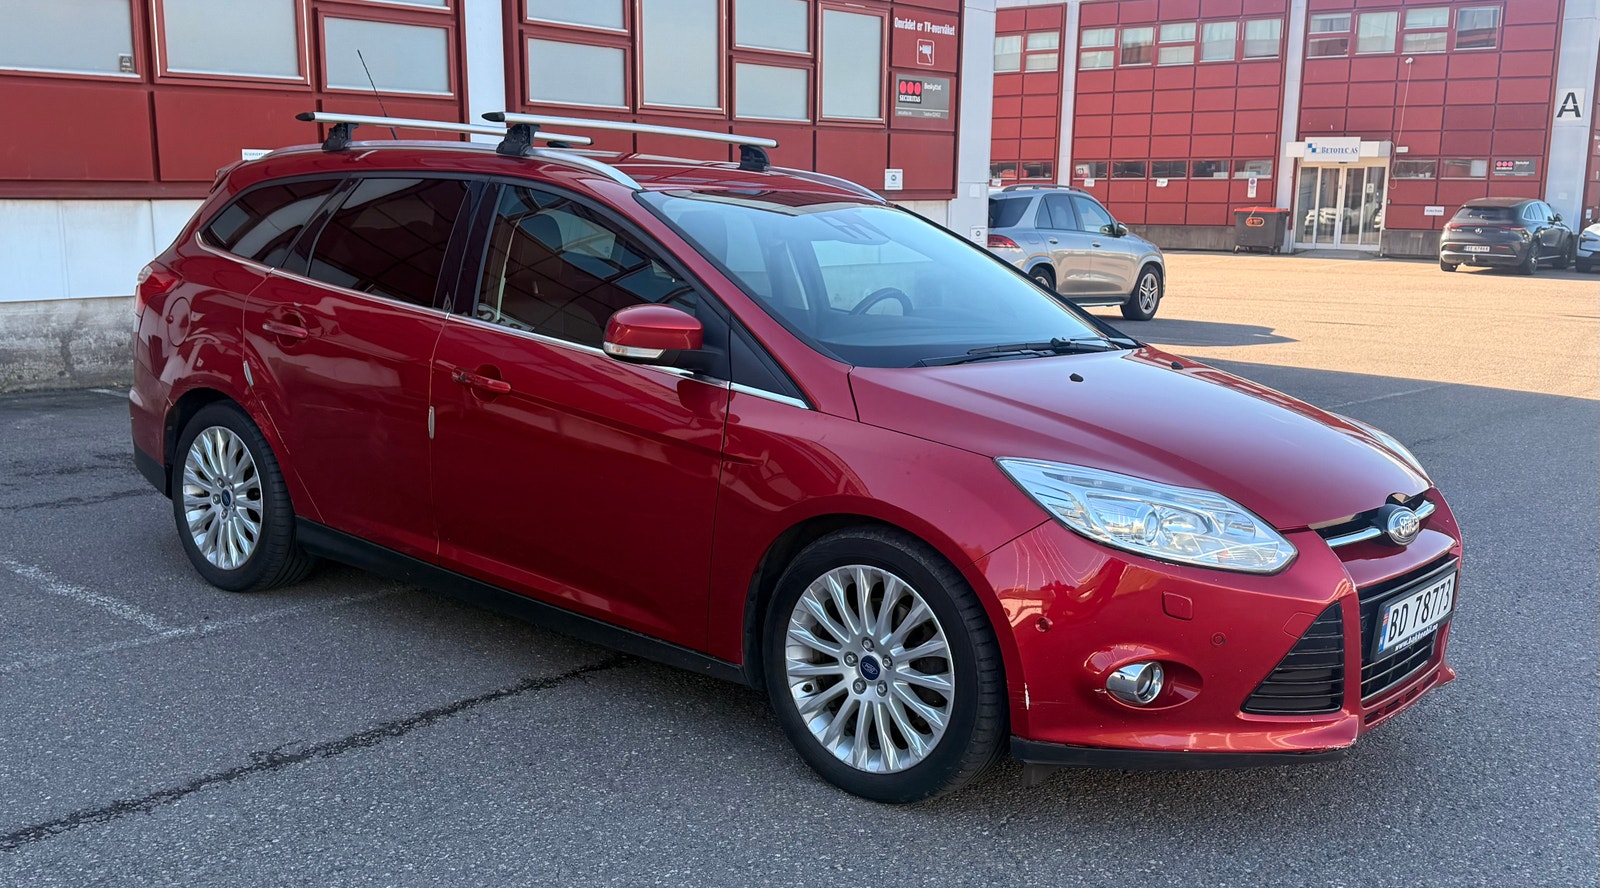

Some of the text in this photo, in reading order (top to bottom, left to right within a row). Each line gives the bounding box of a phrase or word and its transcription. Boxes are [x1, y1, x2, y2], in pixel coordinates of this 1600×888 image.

[894, 16, 916, 31] Området
[916, 22, 923, 31] er
[1556, 91, 1581, 118] A
[1388, 578, 1451, 642] BD 78773
